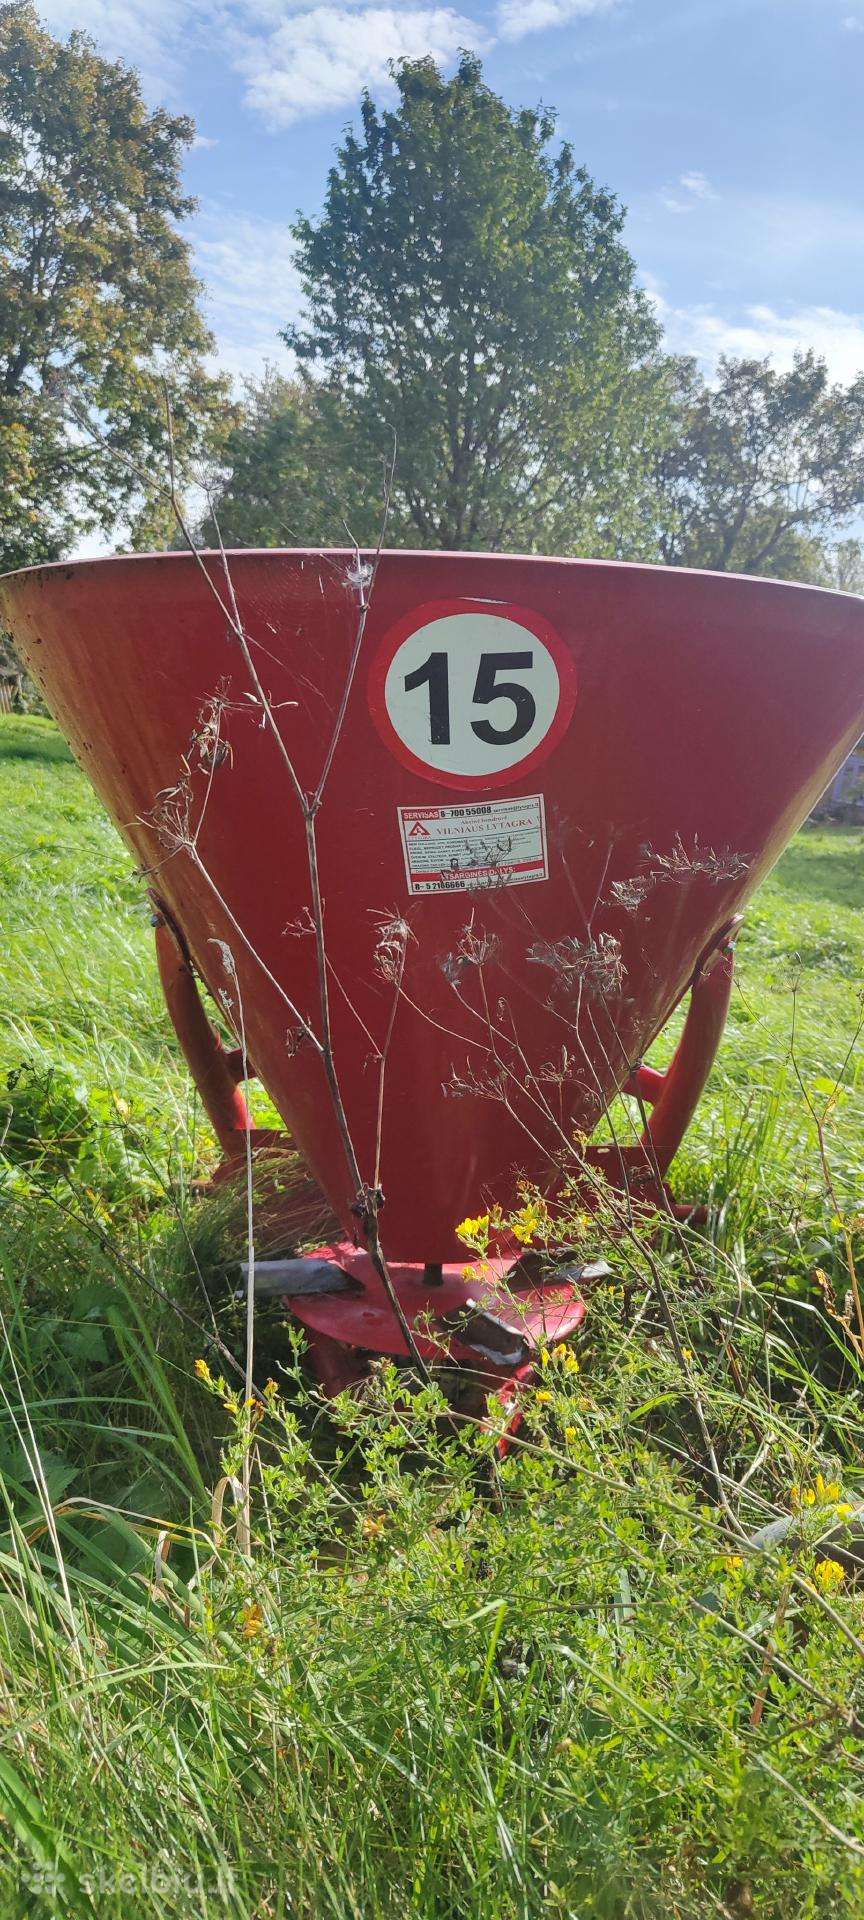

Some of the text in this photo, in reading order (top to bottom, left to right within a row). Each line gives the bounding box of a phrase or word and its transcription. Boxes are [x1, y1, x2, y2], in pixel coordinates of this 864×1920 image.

[404, 651, 536, 746] 15
[403, 811, 439, 820] SERVISAS
[436, 818, 533, 835] VILNIAUS LYTAGRA
